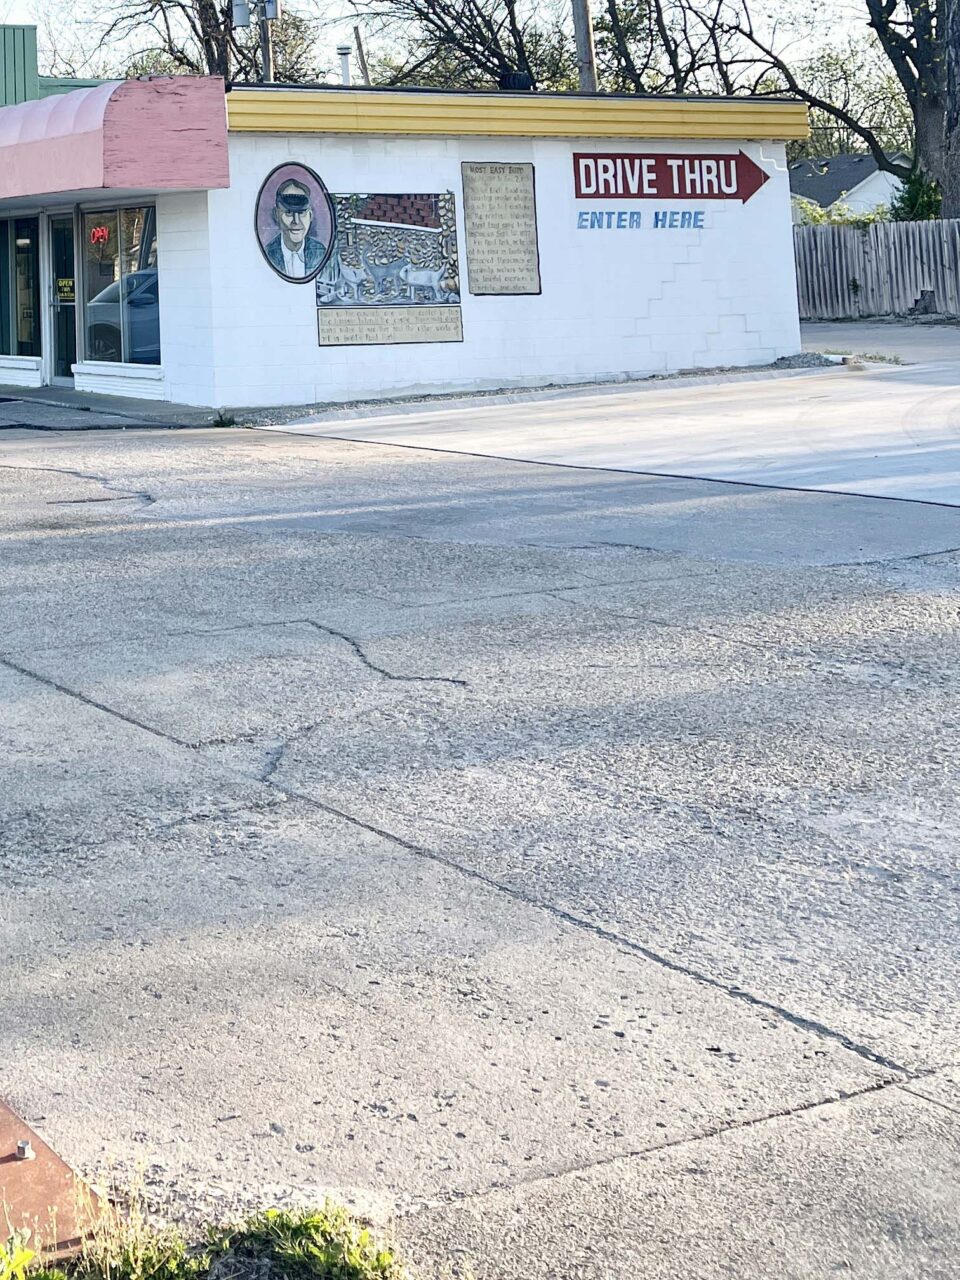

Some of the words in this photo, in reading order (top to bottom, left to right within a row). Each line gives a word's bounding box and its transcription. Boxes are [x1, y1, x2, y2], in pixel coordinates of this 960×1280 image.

[578, 158, 658, 195] DRIVE
[666, 159, 738, 195] THRU
[576, 210, 642, 230] ENTER
[652, 210, 706, 230] HERE
[90, 226, 110, 244] OPEN
